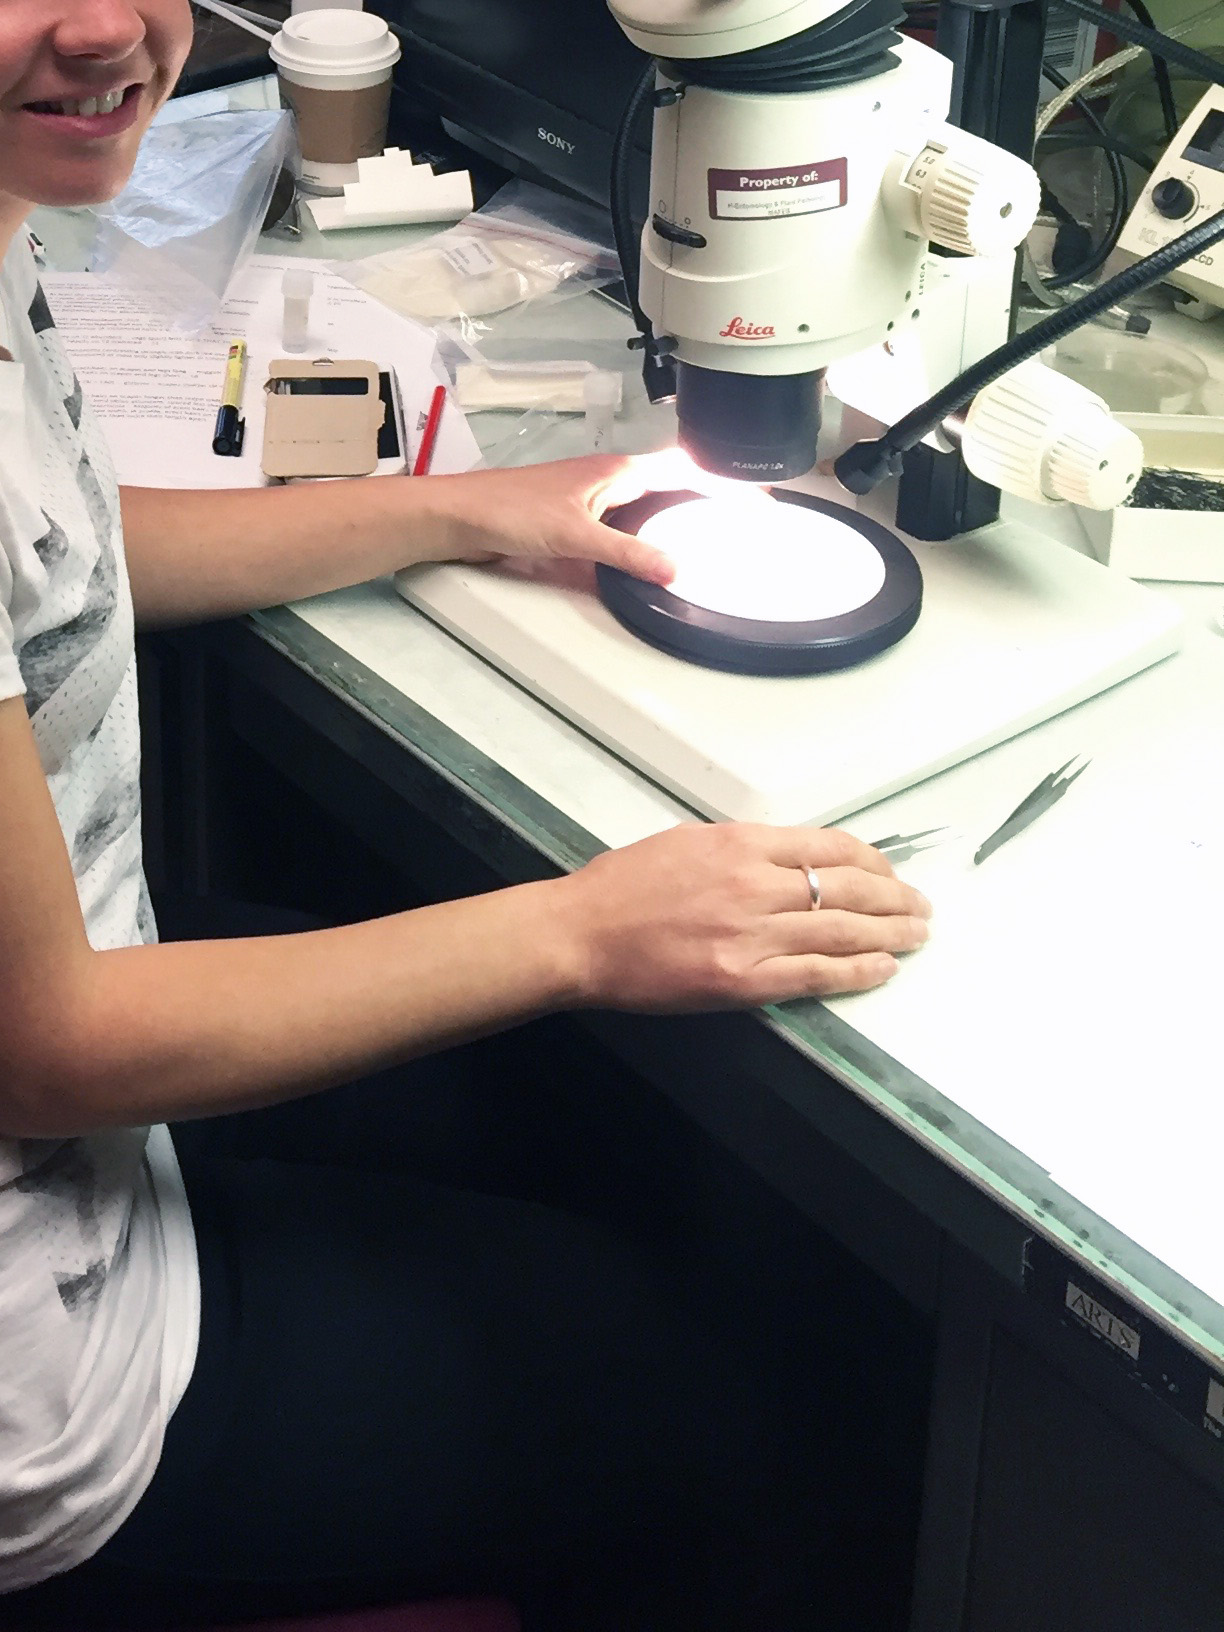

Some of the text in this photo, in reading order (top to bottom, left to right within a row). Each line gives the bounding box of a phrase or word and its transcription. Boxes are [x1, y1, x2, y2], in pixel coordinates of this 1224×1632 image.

[538, 127, 576, 155] SONY
[739, 170, 819, 189] Property of:
[719, 316, 776, 339] Leica
